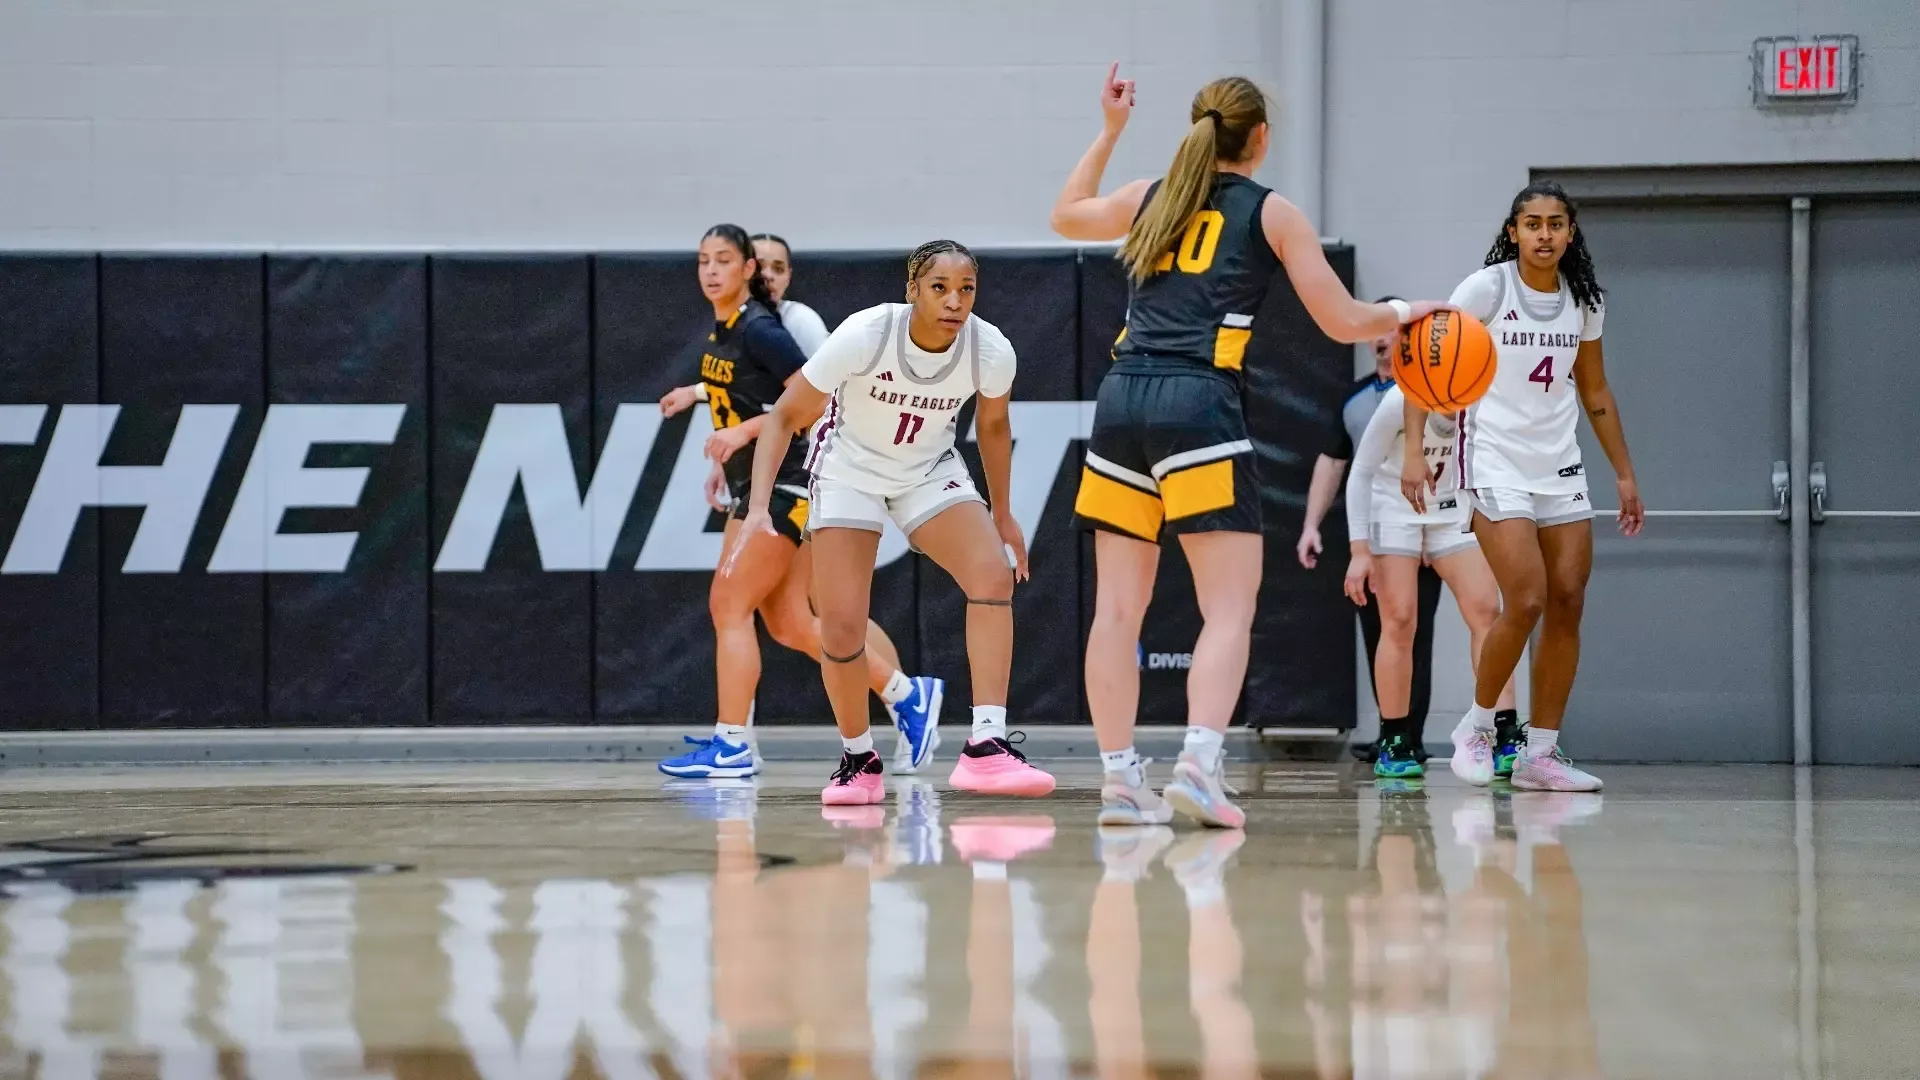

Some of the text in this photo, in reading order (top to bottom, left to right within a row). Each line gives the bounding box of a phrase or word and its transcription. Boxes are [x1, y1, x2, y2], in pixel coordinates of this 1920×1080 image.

[1779, 47, 1839, 90] EXIT
[1155, 210, 1225, 274] 0
[1502, 331, 1535, 347] LADY
[1528, 355, 1554, 393] 4
[869, 384, 962, 410] LADY EAGLES
[893, 411, 925, 446] 11
[0, 402, 1098, 574] HE NT
[1148, 652, 1193, 669] DIVIS
